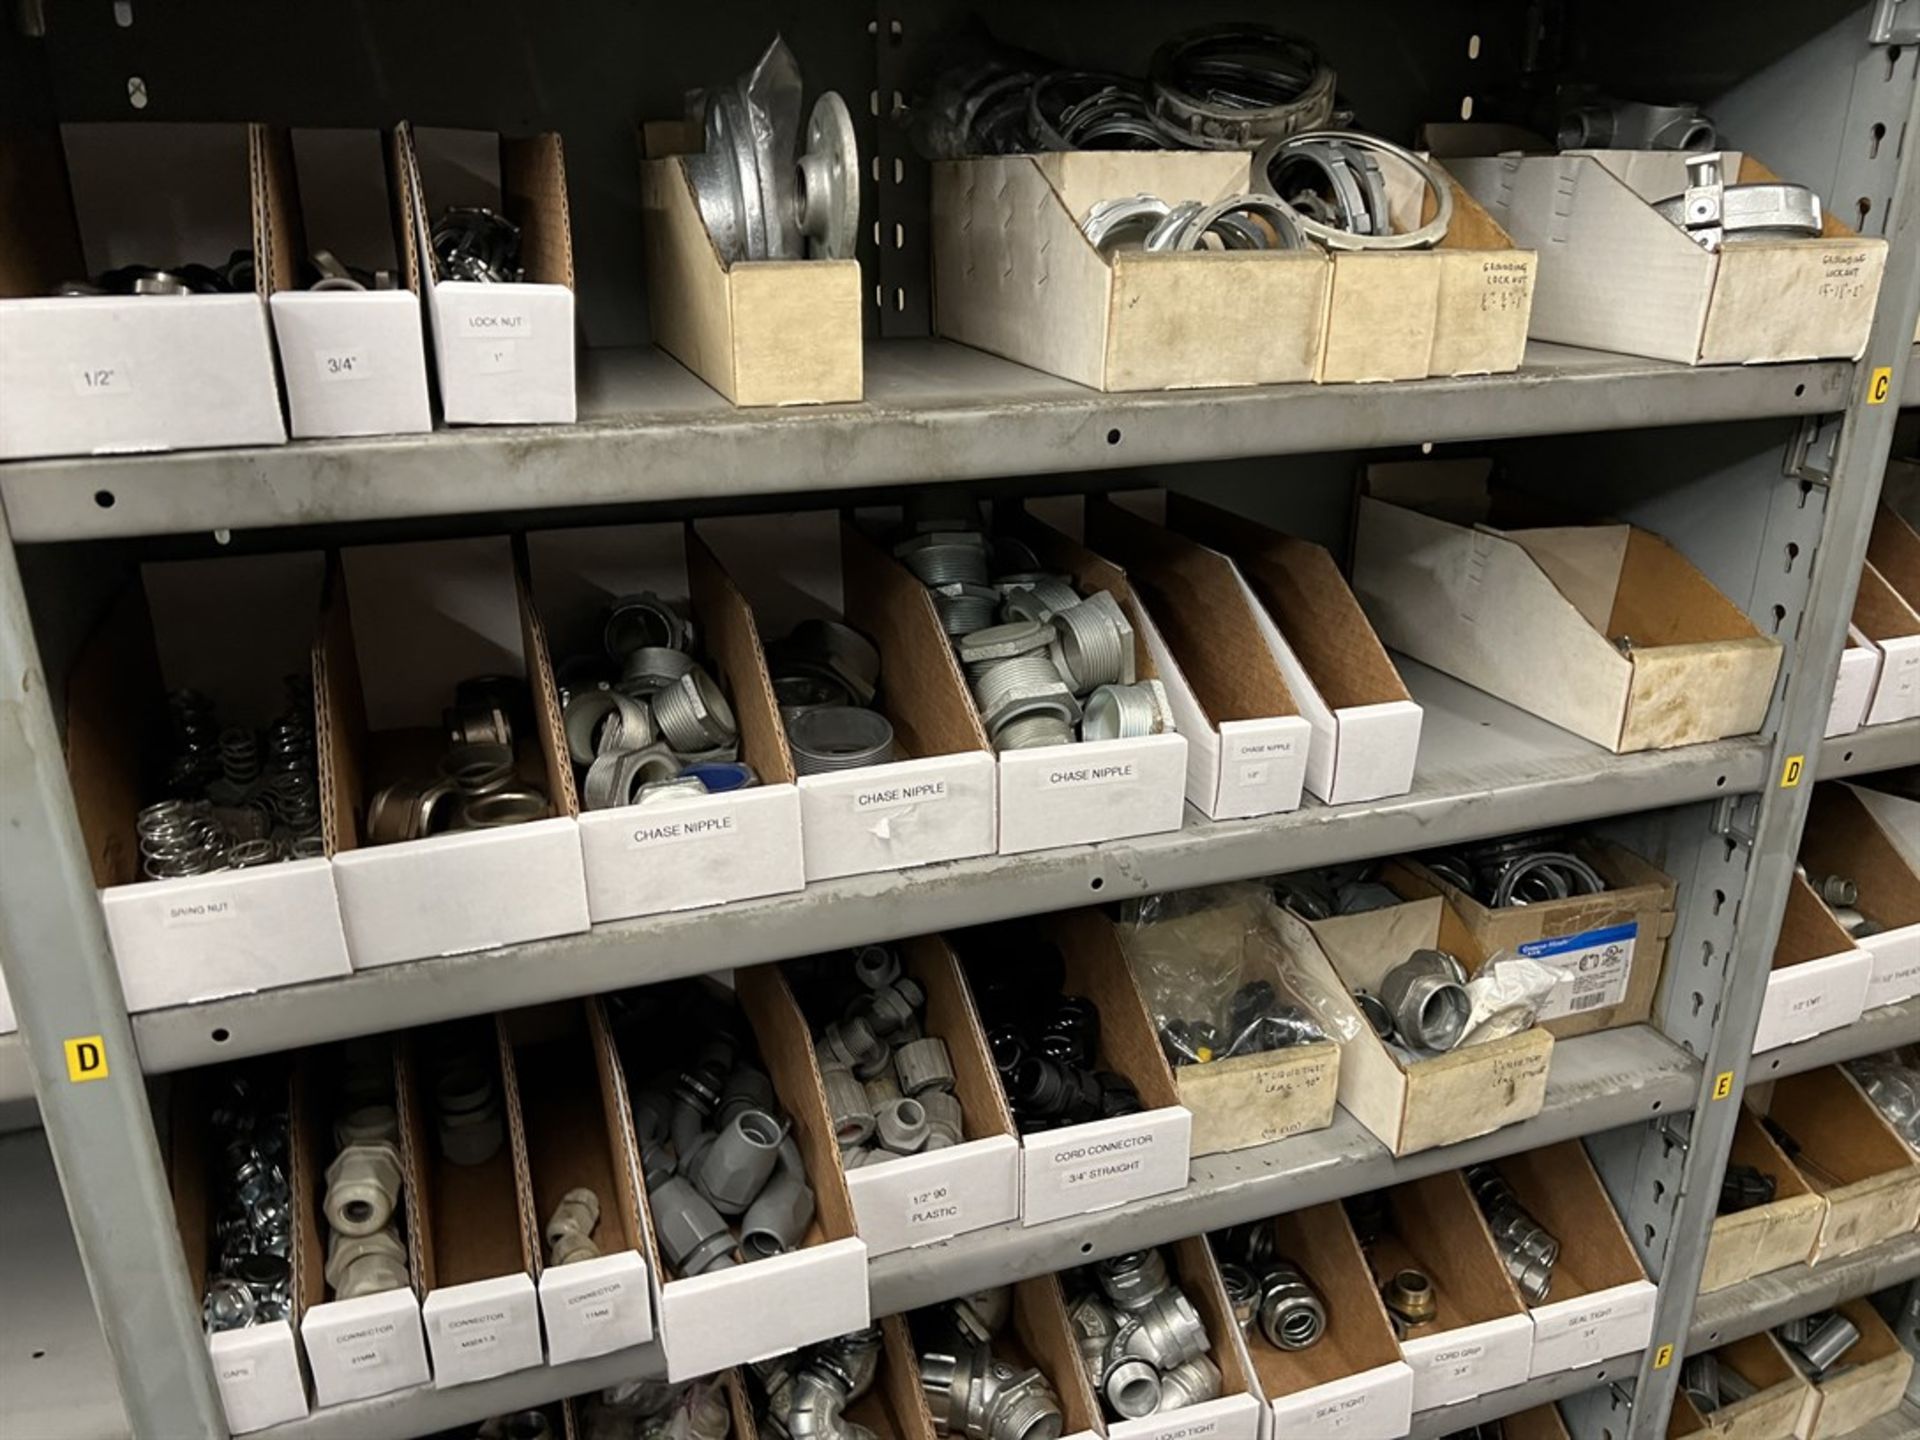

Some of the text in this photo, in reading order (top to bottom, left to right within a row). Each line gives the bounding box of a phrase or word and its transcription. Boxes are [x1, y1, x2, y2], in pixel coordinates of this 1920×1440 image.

[469, 315, 522, 328] LOCK NUT
[327, 356, 357, 373] 3/4"
[84, 368, 114, 387] 1/2"
[1875, 375, 1888, 401] C
[1050, 763, 1133, 785] CHASE NIPPLE
[1787, 761, 1800, 783] D
[858, 780, 945, 806] CHASE NIPPLE
[633, 815, 732, 843] CHASE NIPPLE
[207, 901, 228, 913] NUT
[76, 1042, 101, 1072] D
[1717, 1076, 1729, 1096] E
[1054, 1134, 1153, 1163] CORD CONNECTOR
[1088, 1160, 1140, 1180] STRAIGHT
[932, 1187, 947, 1200] 90
[911, 1206, 958, 1222] PLASTIC
[567, 1283, 622, 1306] CONNECTOR
[448, 1312, 505, 1329] CONNECTOR
[336, 1323, 394, 1345] CONNECTOR
[1434, 1350, 1460, 1362] CORD
[1658, 1347, 1670, 1366] F
[1316, 1395, 1366, 1419] SEAL TIGHT
[1188, 1423, 1216, 1437] TIGHT
